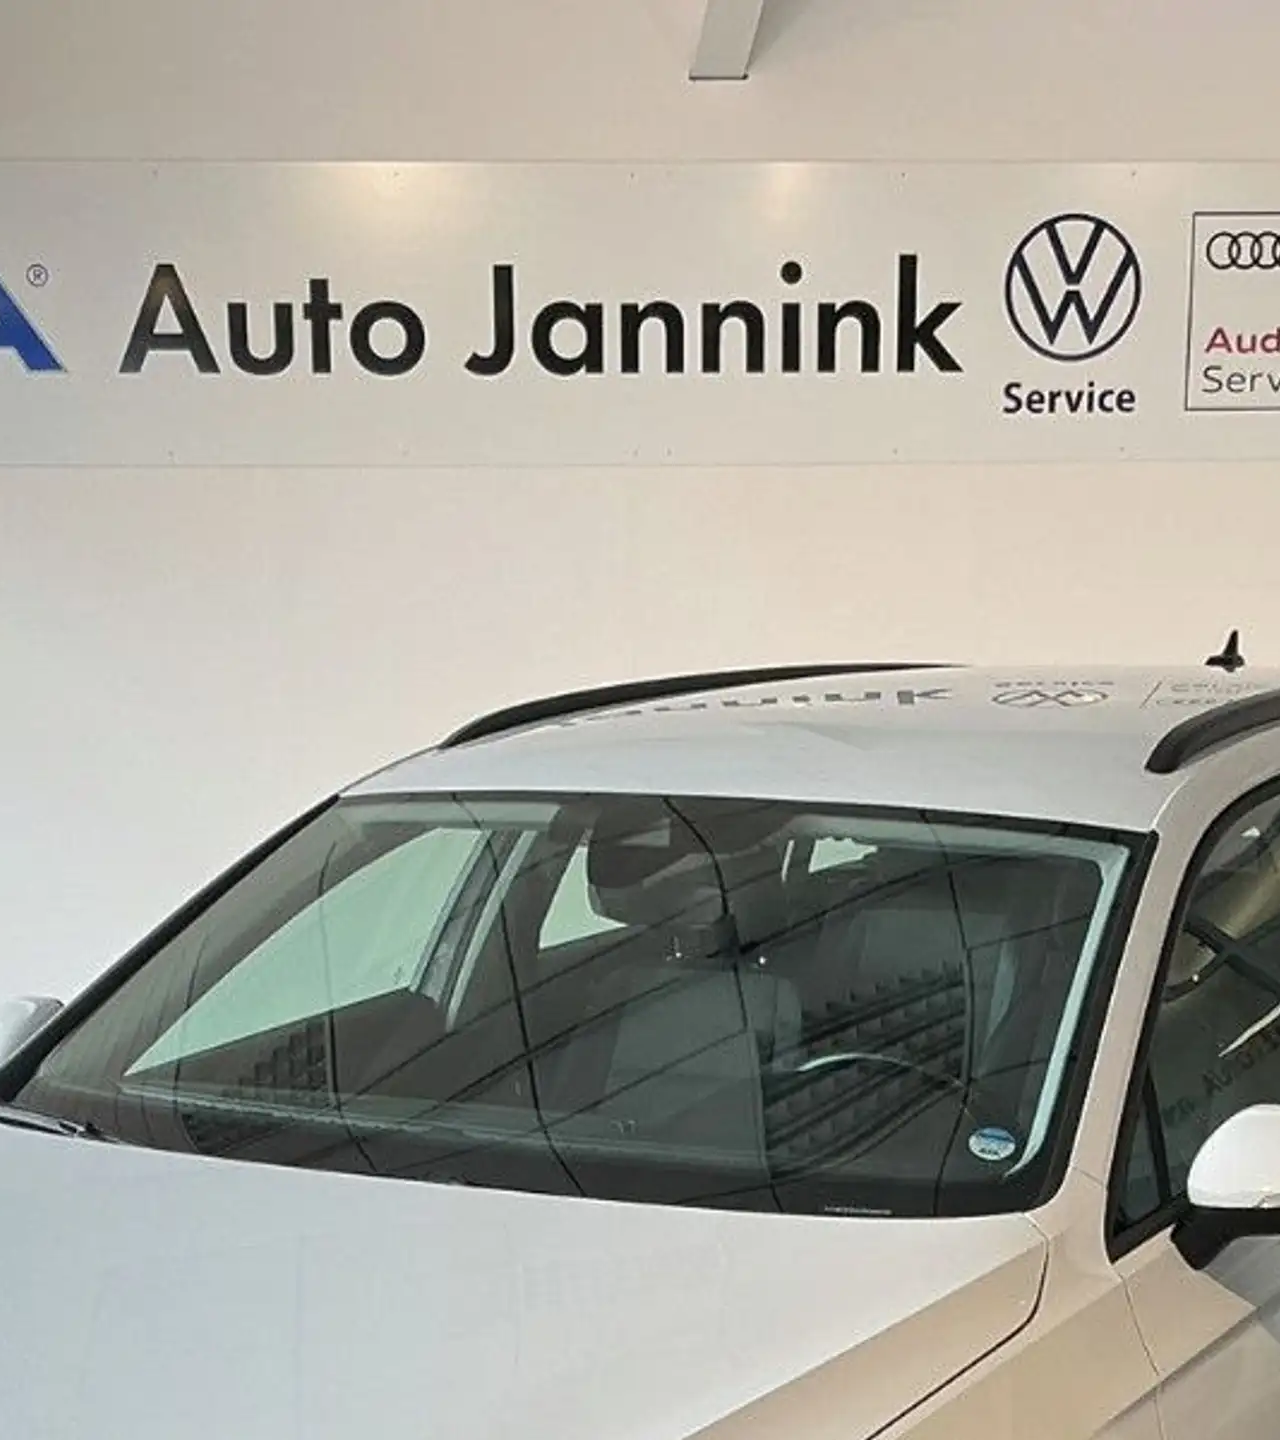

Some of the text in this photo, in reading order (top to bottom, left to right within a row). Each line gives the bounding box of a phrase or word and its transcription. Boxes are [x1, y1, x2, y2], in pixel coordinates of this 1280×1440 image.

[119, 262, 428, 376] Auto
[463, 254, 965, 376] Jannink
[1002, 381, 1137, 414] Service
